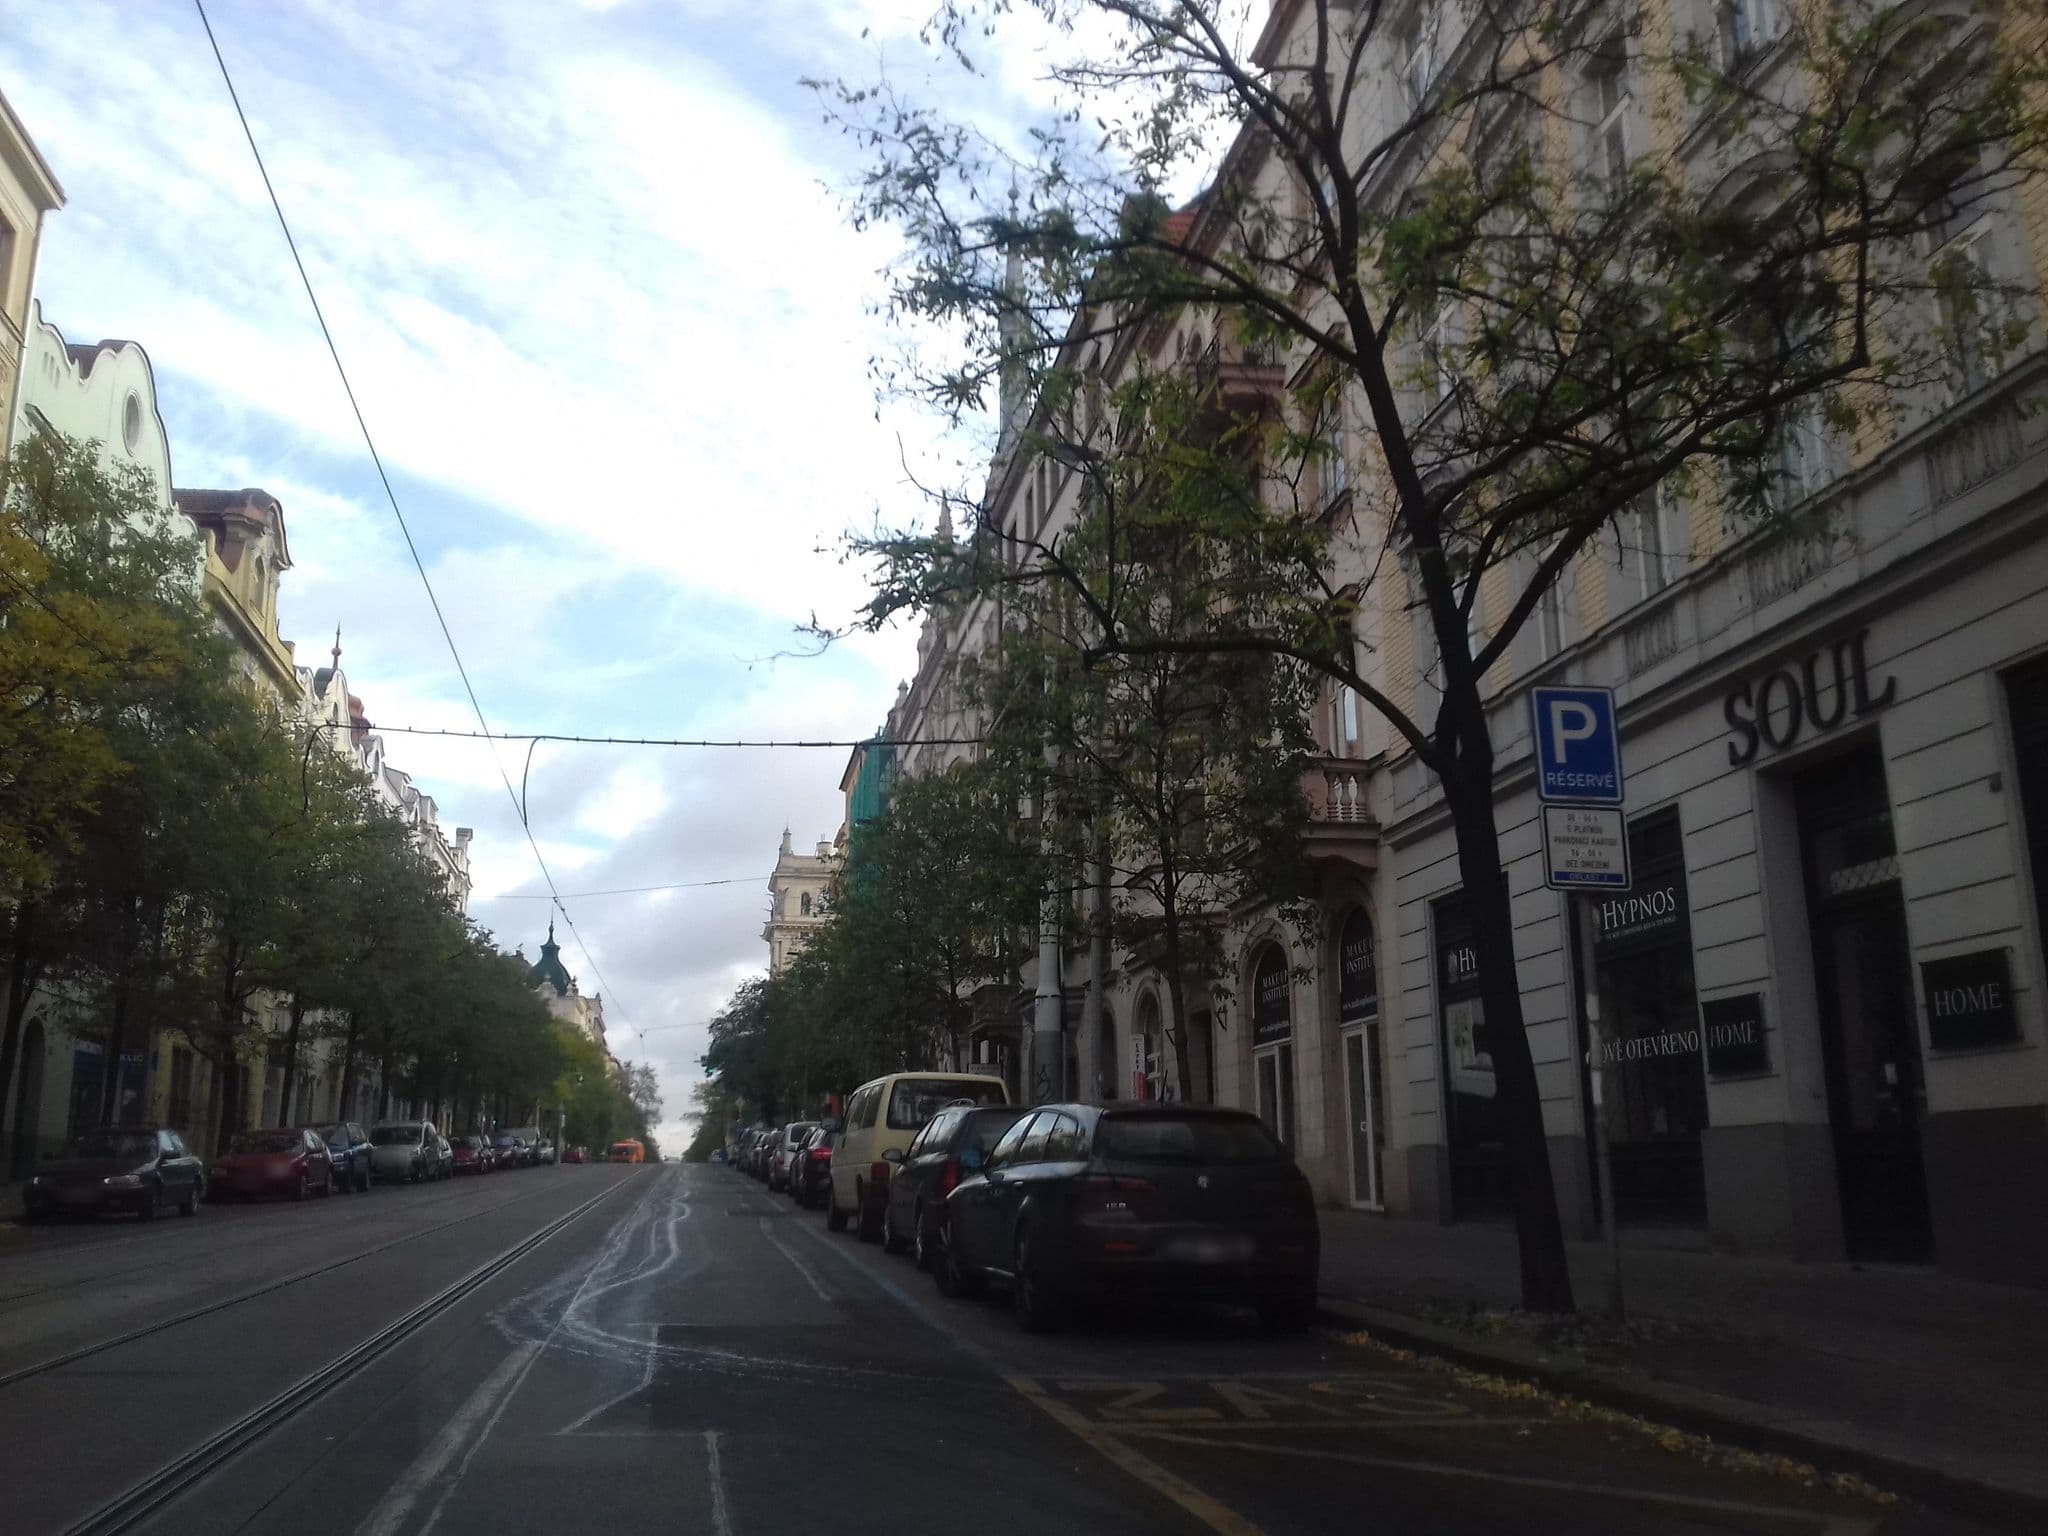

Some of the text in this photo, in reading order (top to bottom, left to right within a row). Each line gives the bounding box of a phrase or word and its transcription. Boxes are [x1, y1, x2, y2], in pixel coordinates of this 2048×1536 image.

[1724, 628, 1897, 766] SOUL
[1551, 700, 1598, 764] P
[1546, 769, 1616, 788] RÉSERVÉ
[1602, 886, 1676, 930] HYPNOS
[1934, 982, 2002, 1017] HOME
[1710, 1020, 1758, 1049] HOME
